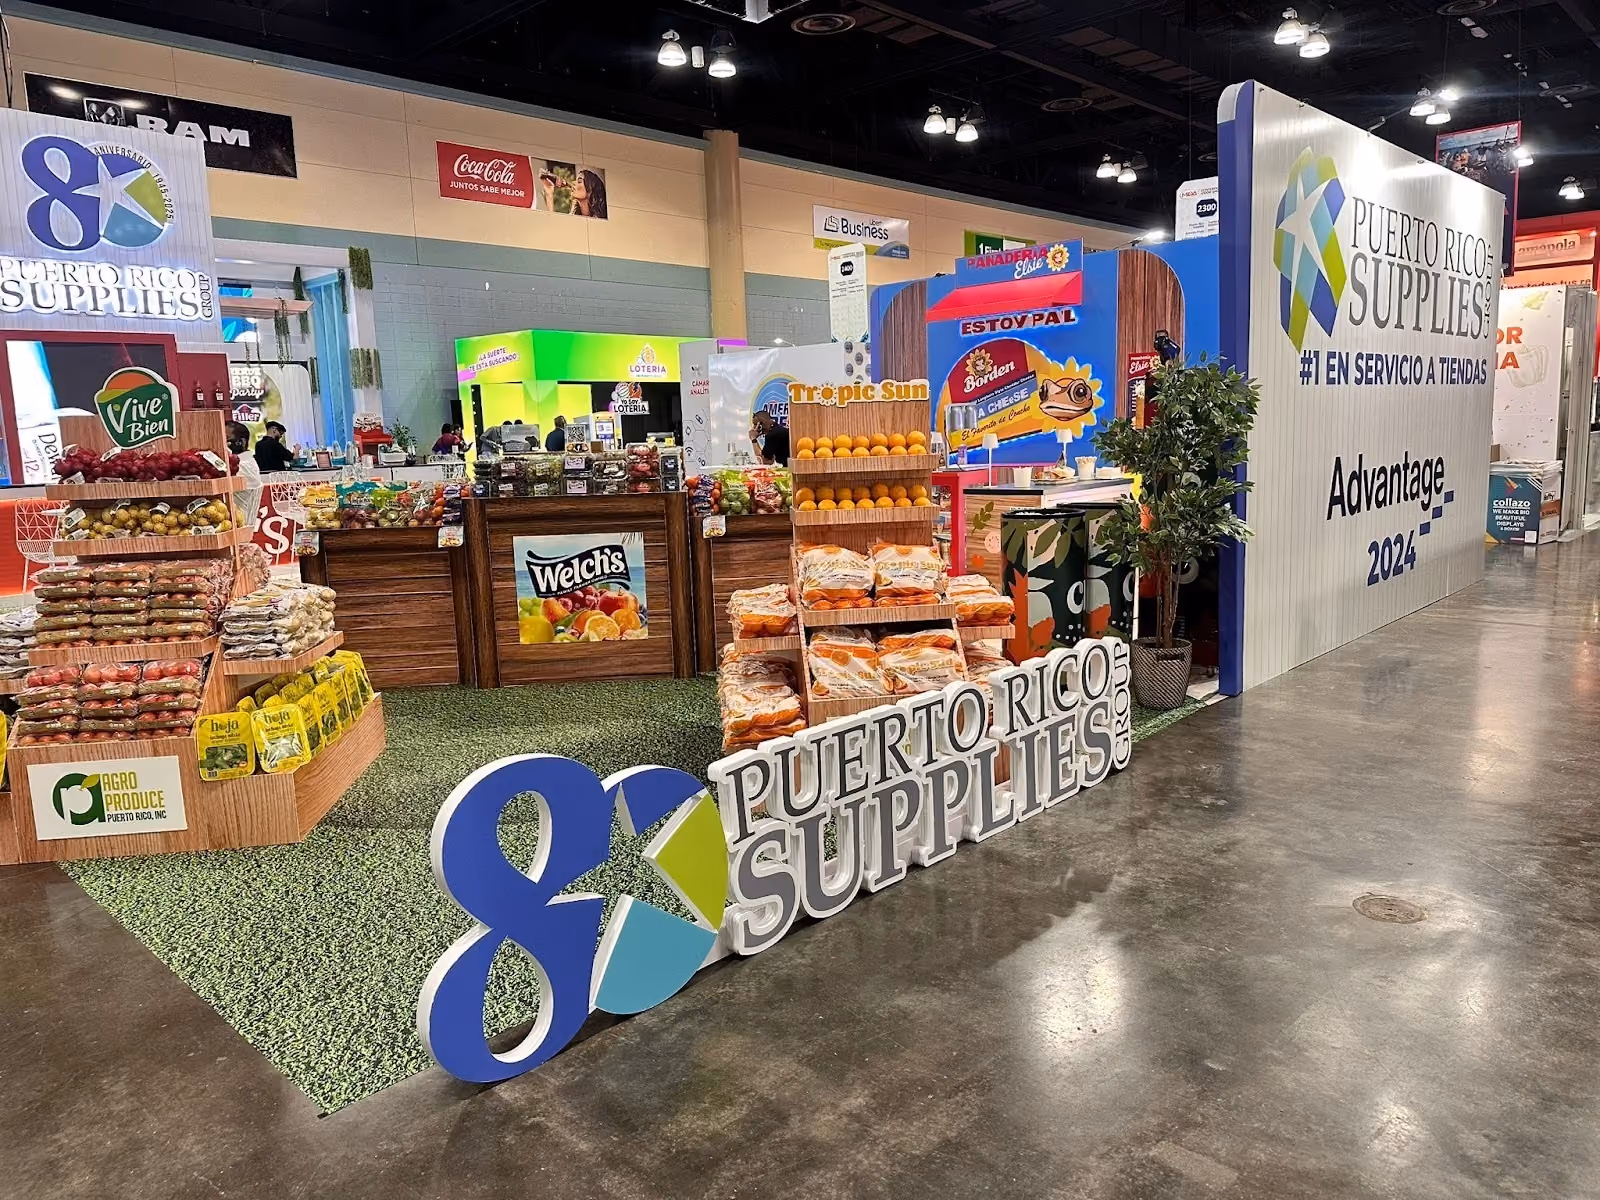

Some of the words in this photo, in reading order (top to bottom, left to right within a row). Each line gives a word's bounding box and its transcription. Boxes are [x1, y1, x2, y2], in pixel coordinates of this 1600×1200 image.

[136, 114, 250, 147] RAM
[94, 145, 152, 169] ANIVERSARIO
[152, 173, 174, 219] 1945-2025
[454, 153, 517, 185] Coca-Cola
[450, 181, 479, 191] JUNTOS
[480, 185, 499, 194] SABE
[501, 188, 525, 198] MEJOR
[1197, 203, 1216, 213] 2300
[840, 217, 889, 240] Business
[1351, 196, 1440, 268] PUERTO
[1442, 228, 1487, 279] RICO
[0, 257, 119, 285] PUERTO
[131, 269, 196, 290] RICO
[1014, 256, 1043, 279] Elsie
[0, 279, 200, 318] SUPPLIES
[200, 275, 213, 320] GROUP
[1348, 251, 1485, 340] SUPPLIES
[1483, 244, 1495, 340] GROUP
[962, 315, 1028, 335] ESTOY
[487, 348, 507, 359] SUERTE
[1129, 361, 1149, 375] Elsie
[1300, 350, 1320, 386] #1
[1326, 351, 1349, 386] EN
[1354, 352, 1422, 386] SERVICIO
[1426, 356, 1436, 385] A
[1439, 357, 1487, 386] TIENDAS
[231, 375, 261, 389] BBQ
[963, 361, 1016, 393] Borden
[789, 381, 876, 406] Tropic
[880, 381, 928, 401] Sun
[106, 397, 164, 434] Vive
[126, 418, 169, 442] Bien
[961, 429, 970, 441] El
[1327, 451, 1444, 521] Advantage
[1493, 497, 1531, 508] collazo
[1495, 514, 1527, 522] BEAUTIFUL
[530, 548, 626, 593] Welch's
[1367, 530, 1416, 587] 2024
[1113, 641, 1130, 765] GROUP
[726, 687, 986, 846] PUERTO
[1004, 643, 1111, 738] RICO
[103, 771, 138, 790] AGRO
[104, 790, 165, 811] PRODUCE
[107, 812, 134, 823] PUERTO
[154, 810, 167, 820] INC
[739, 700, 1112, 950] SUPPLIES
